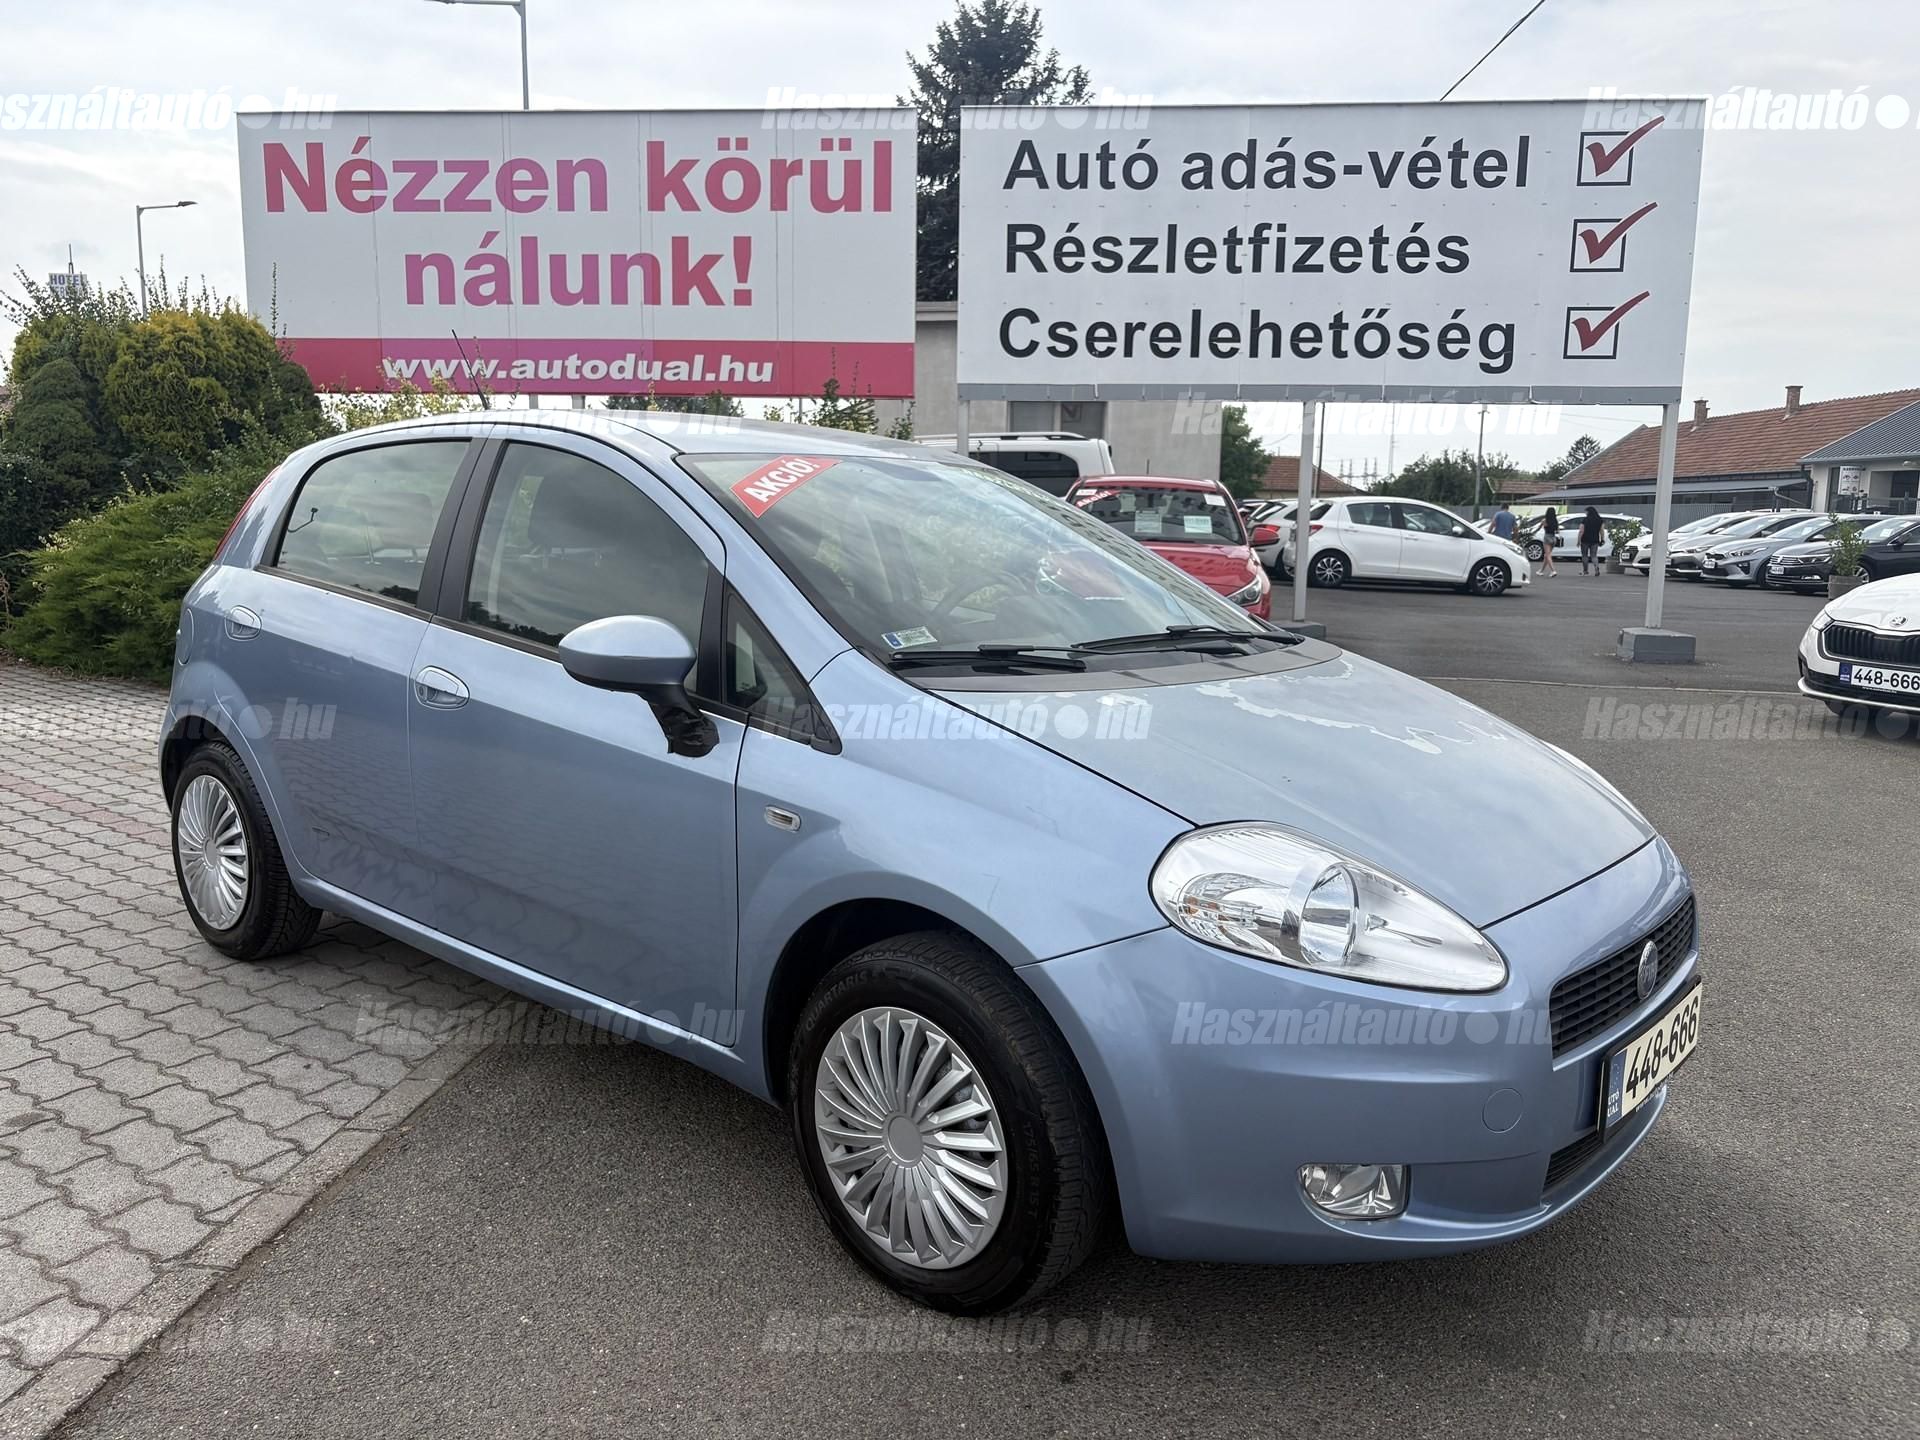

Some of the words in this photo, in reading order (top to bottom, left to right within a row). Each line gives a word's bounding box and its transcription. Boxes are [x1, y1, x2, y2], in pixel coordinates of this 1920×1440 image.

[264, 137, 608, 213] Nézzen
[646, 137, 892, 213] körül
[1002, 138, 1159, 191] Autó
[1181, 135, 1530, 191] adás-vétel
[405, 231, 752, 306] nálunk!
[1006, 221, 1470, 275] Részletfizetés
[381, 352, 774, 383] www.autodual.hu
[999, 307, 1516, 375] Cserelehetőség
[744, 458, 820, 503] AKCIÓ!
[1853, 668, 1920, 691] 448-666
[1625, 995, 1699, 1099] 448-666
